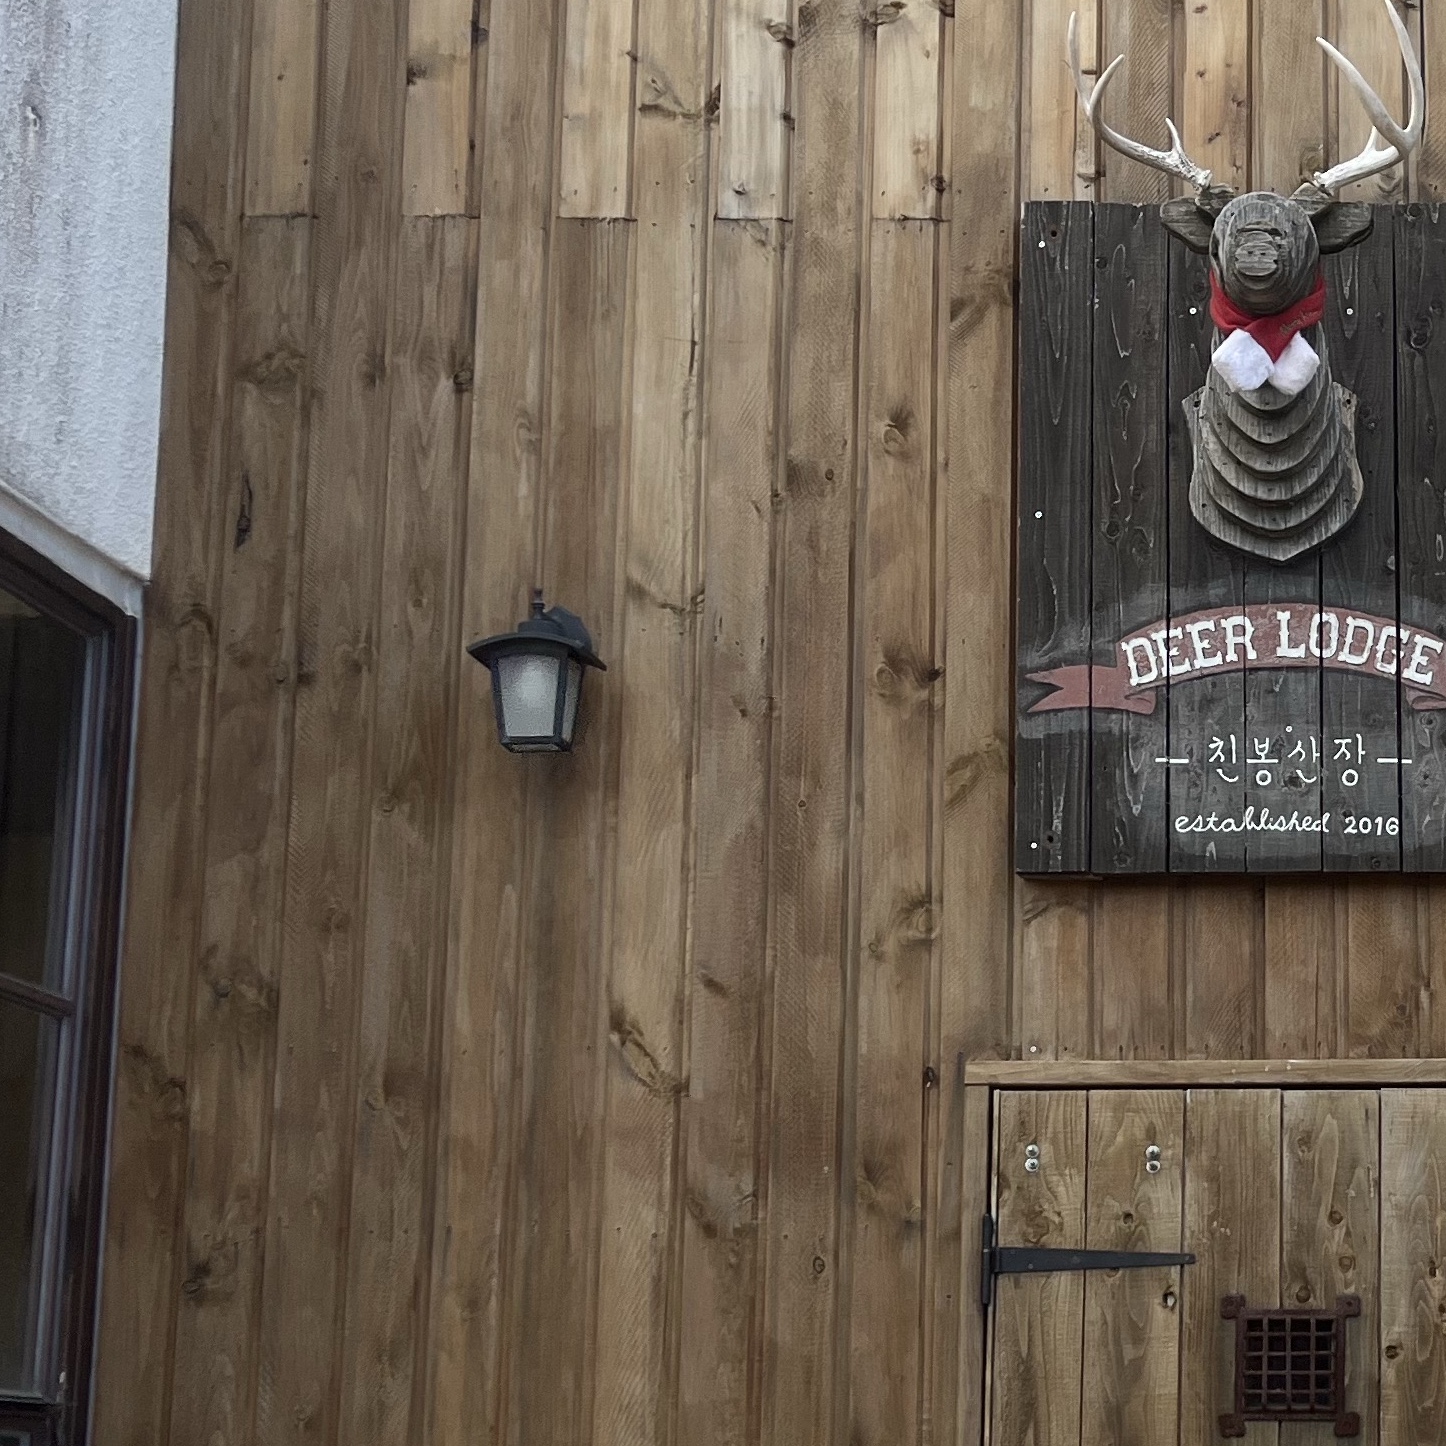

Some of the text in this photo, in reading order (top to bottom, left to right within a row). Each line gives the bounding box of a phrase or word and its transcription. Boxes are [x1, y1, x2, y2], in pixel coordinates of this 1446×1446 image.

[1121, 610, 1444, 687] DEER LODGE
[1208, 733, 1366, 787] 친봉산장
[1174, 805, 1399, 836] established 2016
